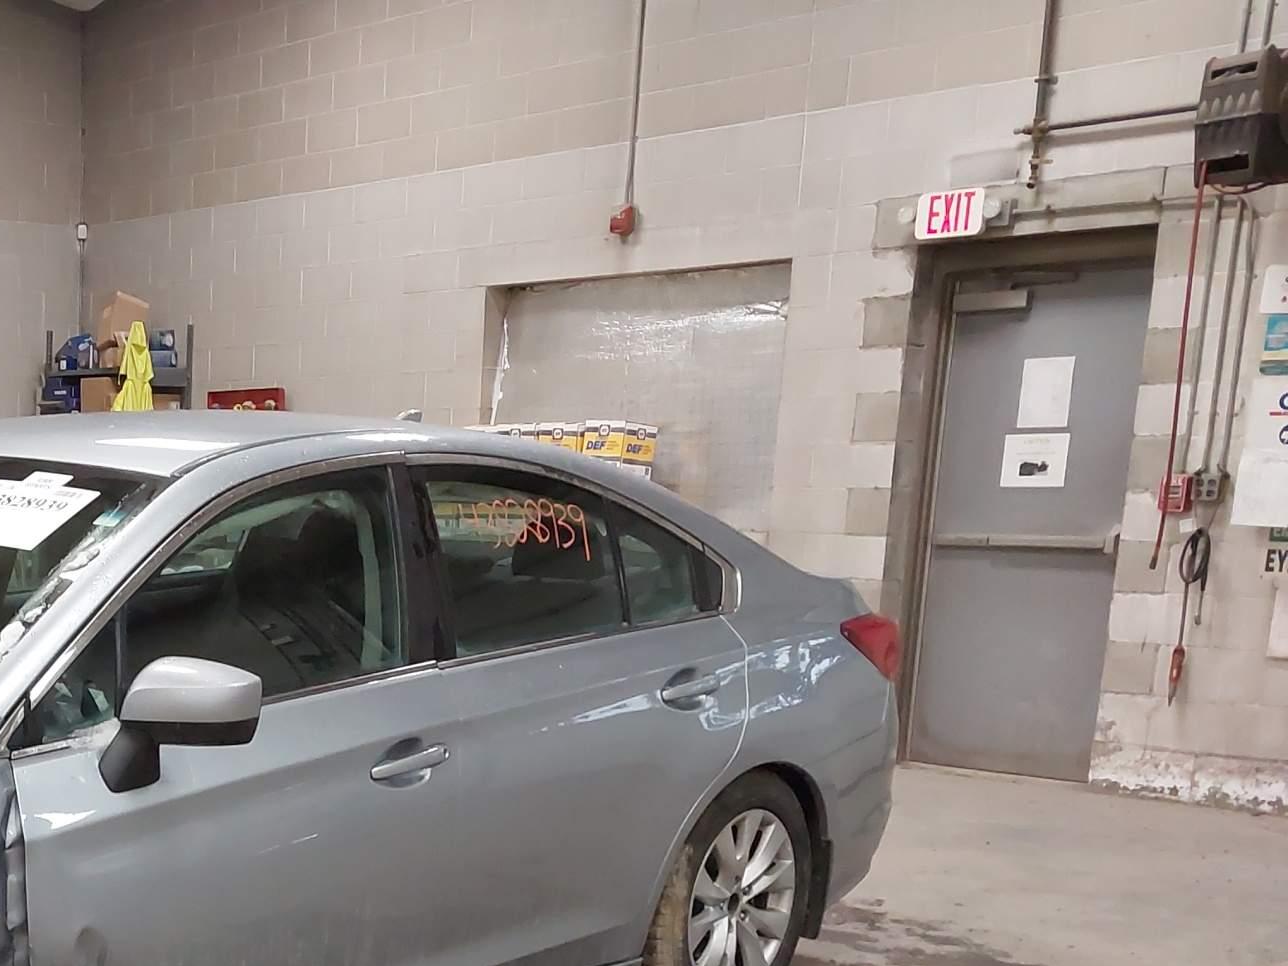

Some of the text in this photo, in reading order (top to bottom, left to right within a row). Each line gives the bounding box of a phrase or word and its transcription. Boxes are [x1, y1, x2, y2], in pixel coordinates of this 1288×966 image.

[927, 191, 976, 235] EXIT
[586, 440, 607, 450] DEF
[1264, 549, 1288, 573] EY
